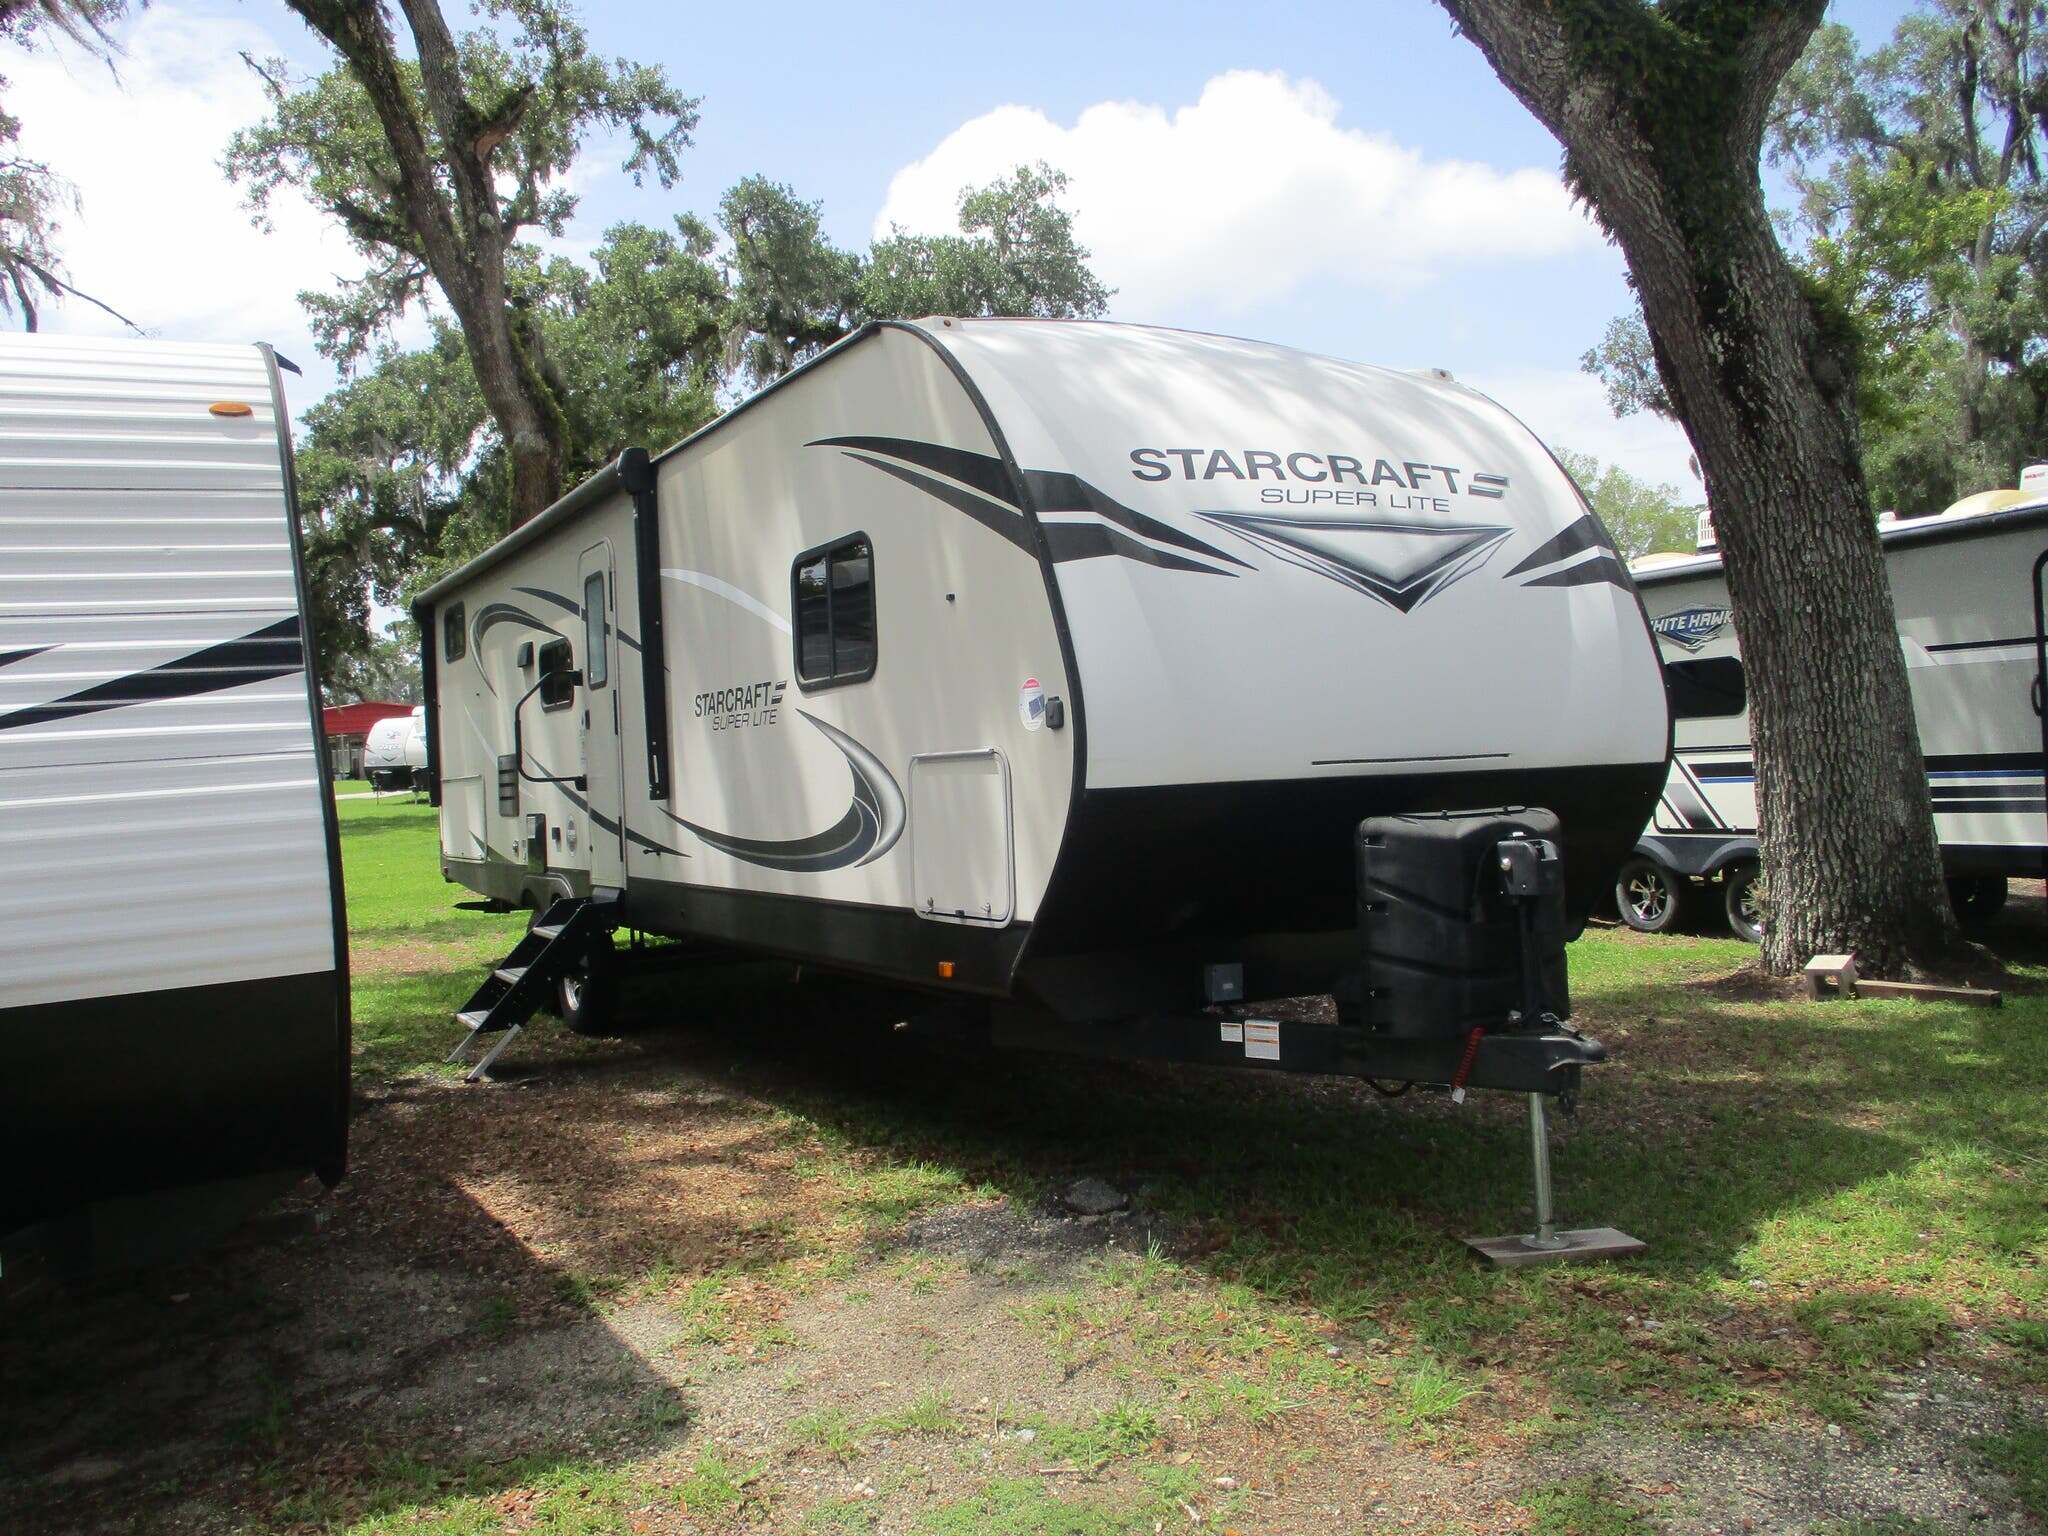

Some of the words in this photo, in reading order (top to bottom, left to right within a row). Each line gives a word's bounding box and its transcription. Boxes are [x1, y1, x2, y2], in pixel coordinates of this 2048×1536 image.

[1129, 448, 1460, 494] STARCRAFT
[1260, 487, 1377, 507] SUPER
[1390, 493, 1451, 513] LITE
[1688, 611, 1734, 628] HAWK
[694, 682, 771, 717] STARCRAFT
[713, 713, 749, 731] SUPER
[753, 709, 777, 726] LITE
